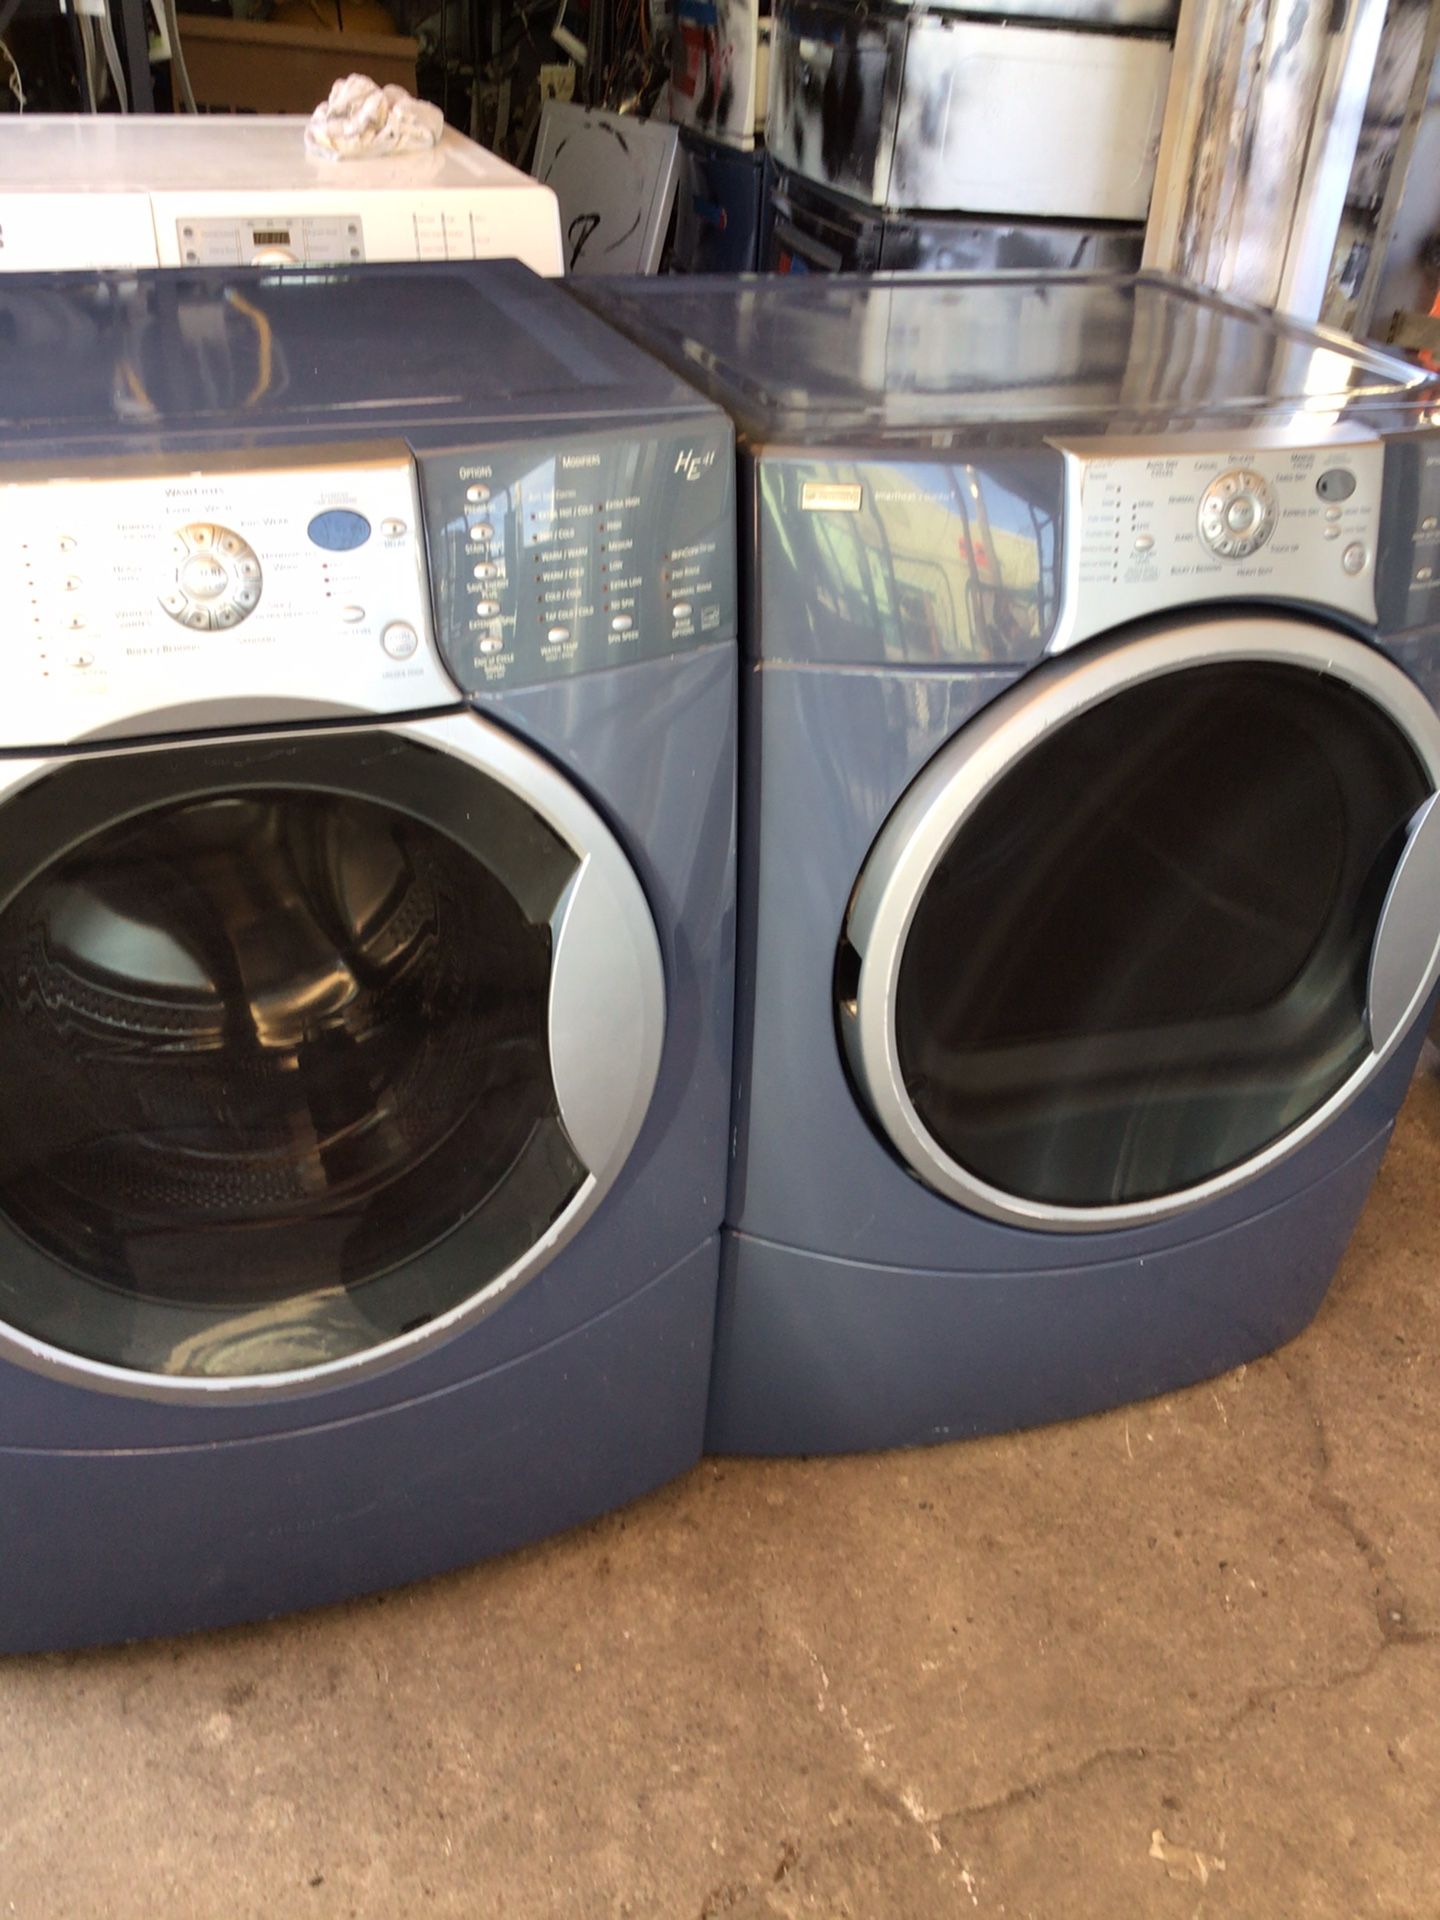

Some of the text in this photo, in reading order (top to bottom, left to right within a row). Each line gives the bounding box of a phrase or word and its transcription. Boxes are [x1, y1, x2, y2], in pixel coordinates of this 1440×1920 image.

[458, 465, 493, 480] OPTIONS
[541, 550, 563, 562] WARM
[542, 570, 564, 583] WARM
